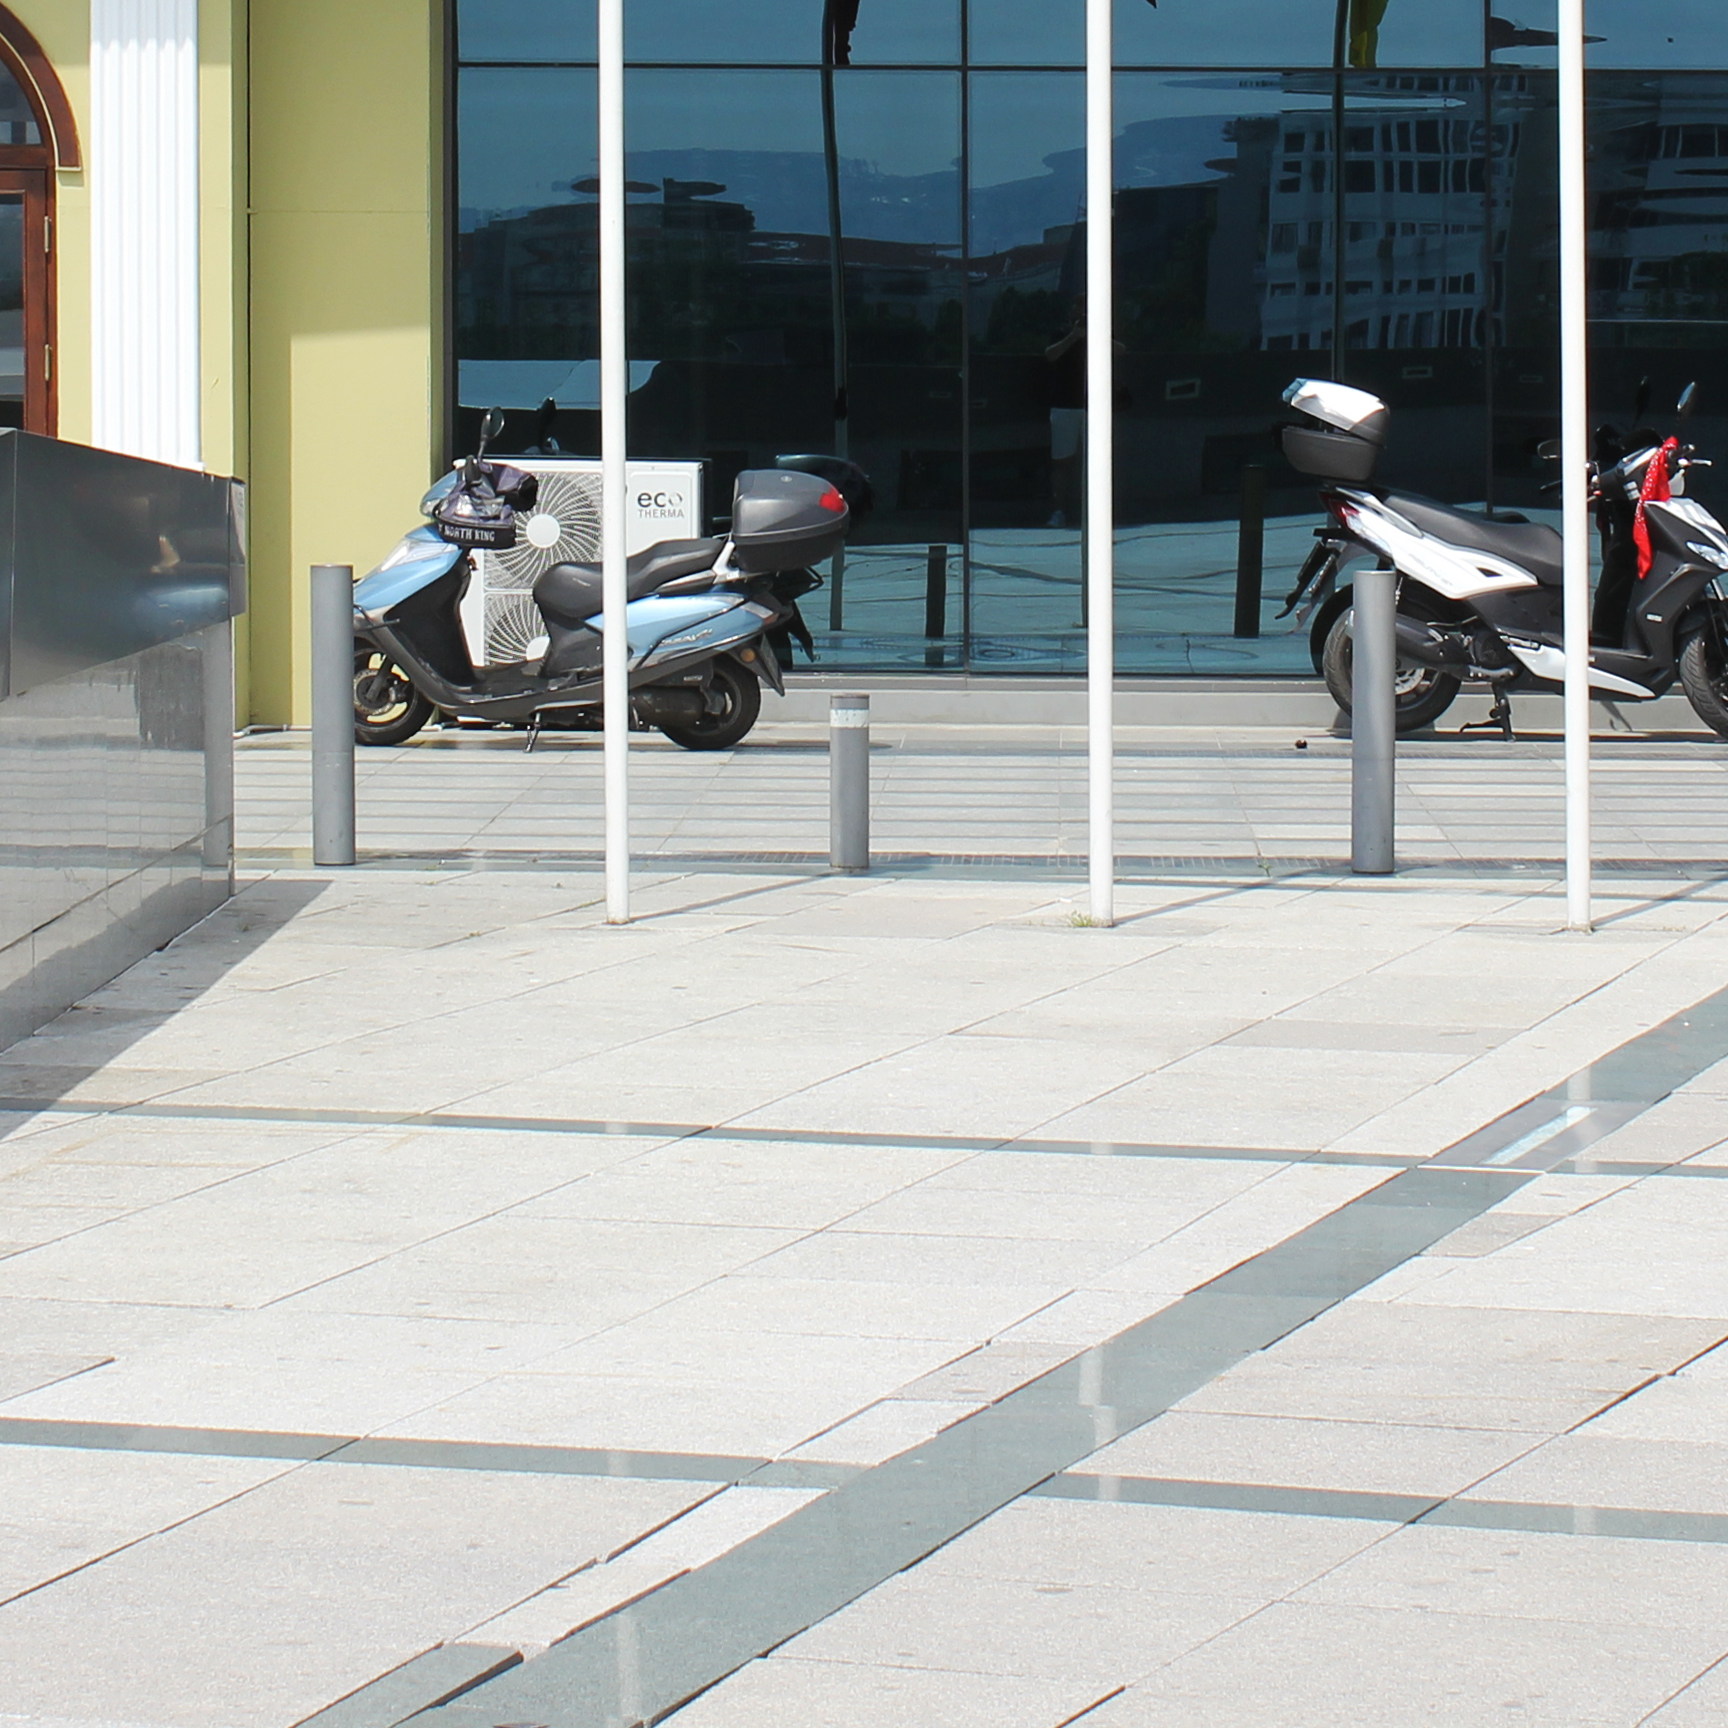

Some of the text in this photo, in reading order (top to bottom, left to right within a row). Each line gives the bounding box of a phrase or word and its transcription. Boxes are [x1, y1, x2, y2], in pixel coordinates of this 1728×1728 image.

[637, 492, 683, 508] eco
[638, 508, 685, 519] THERMA
[443, 524, 472, 541] NORTH
[474, 529, 496, 543] KING
